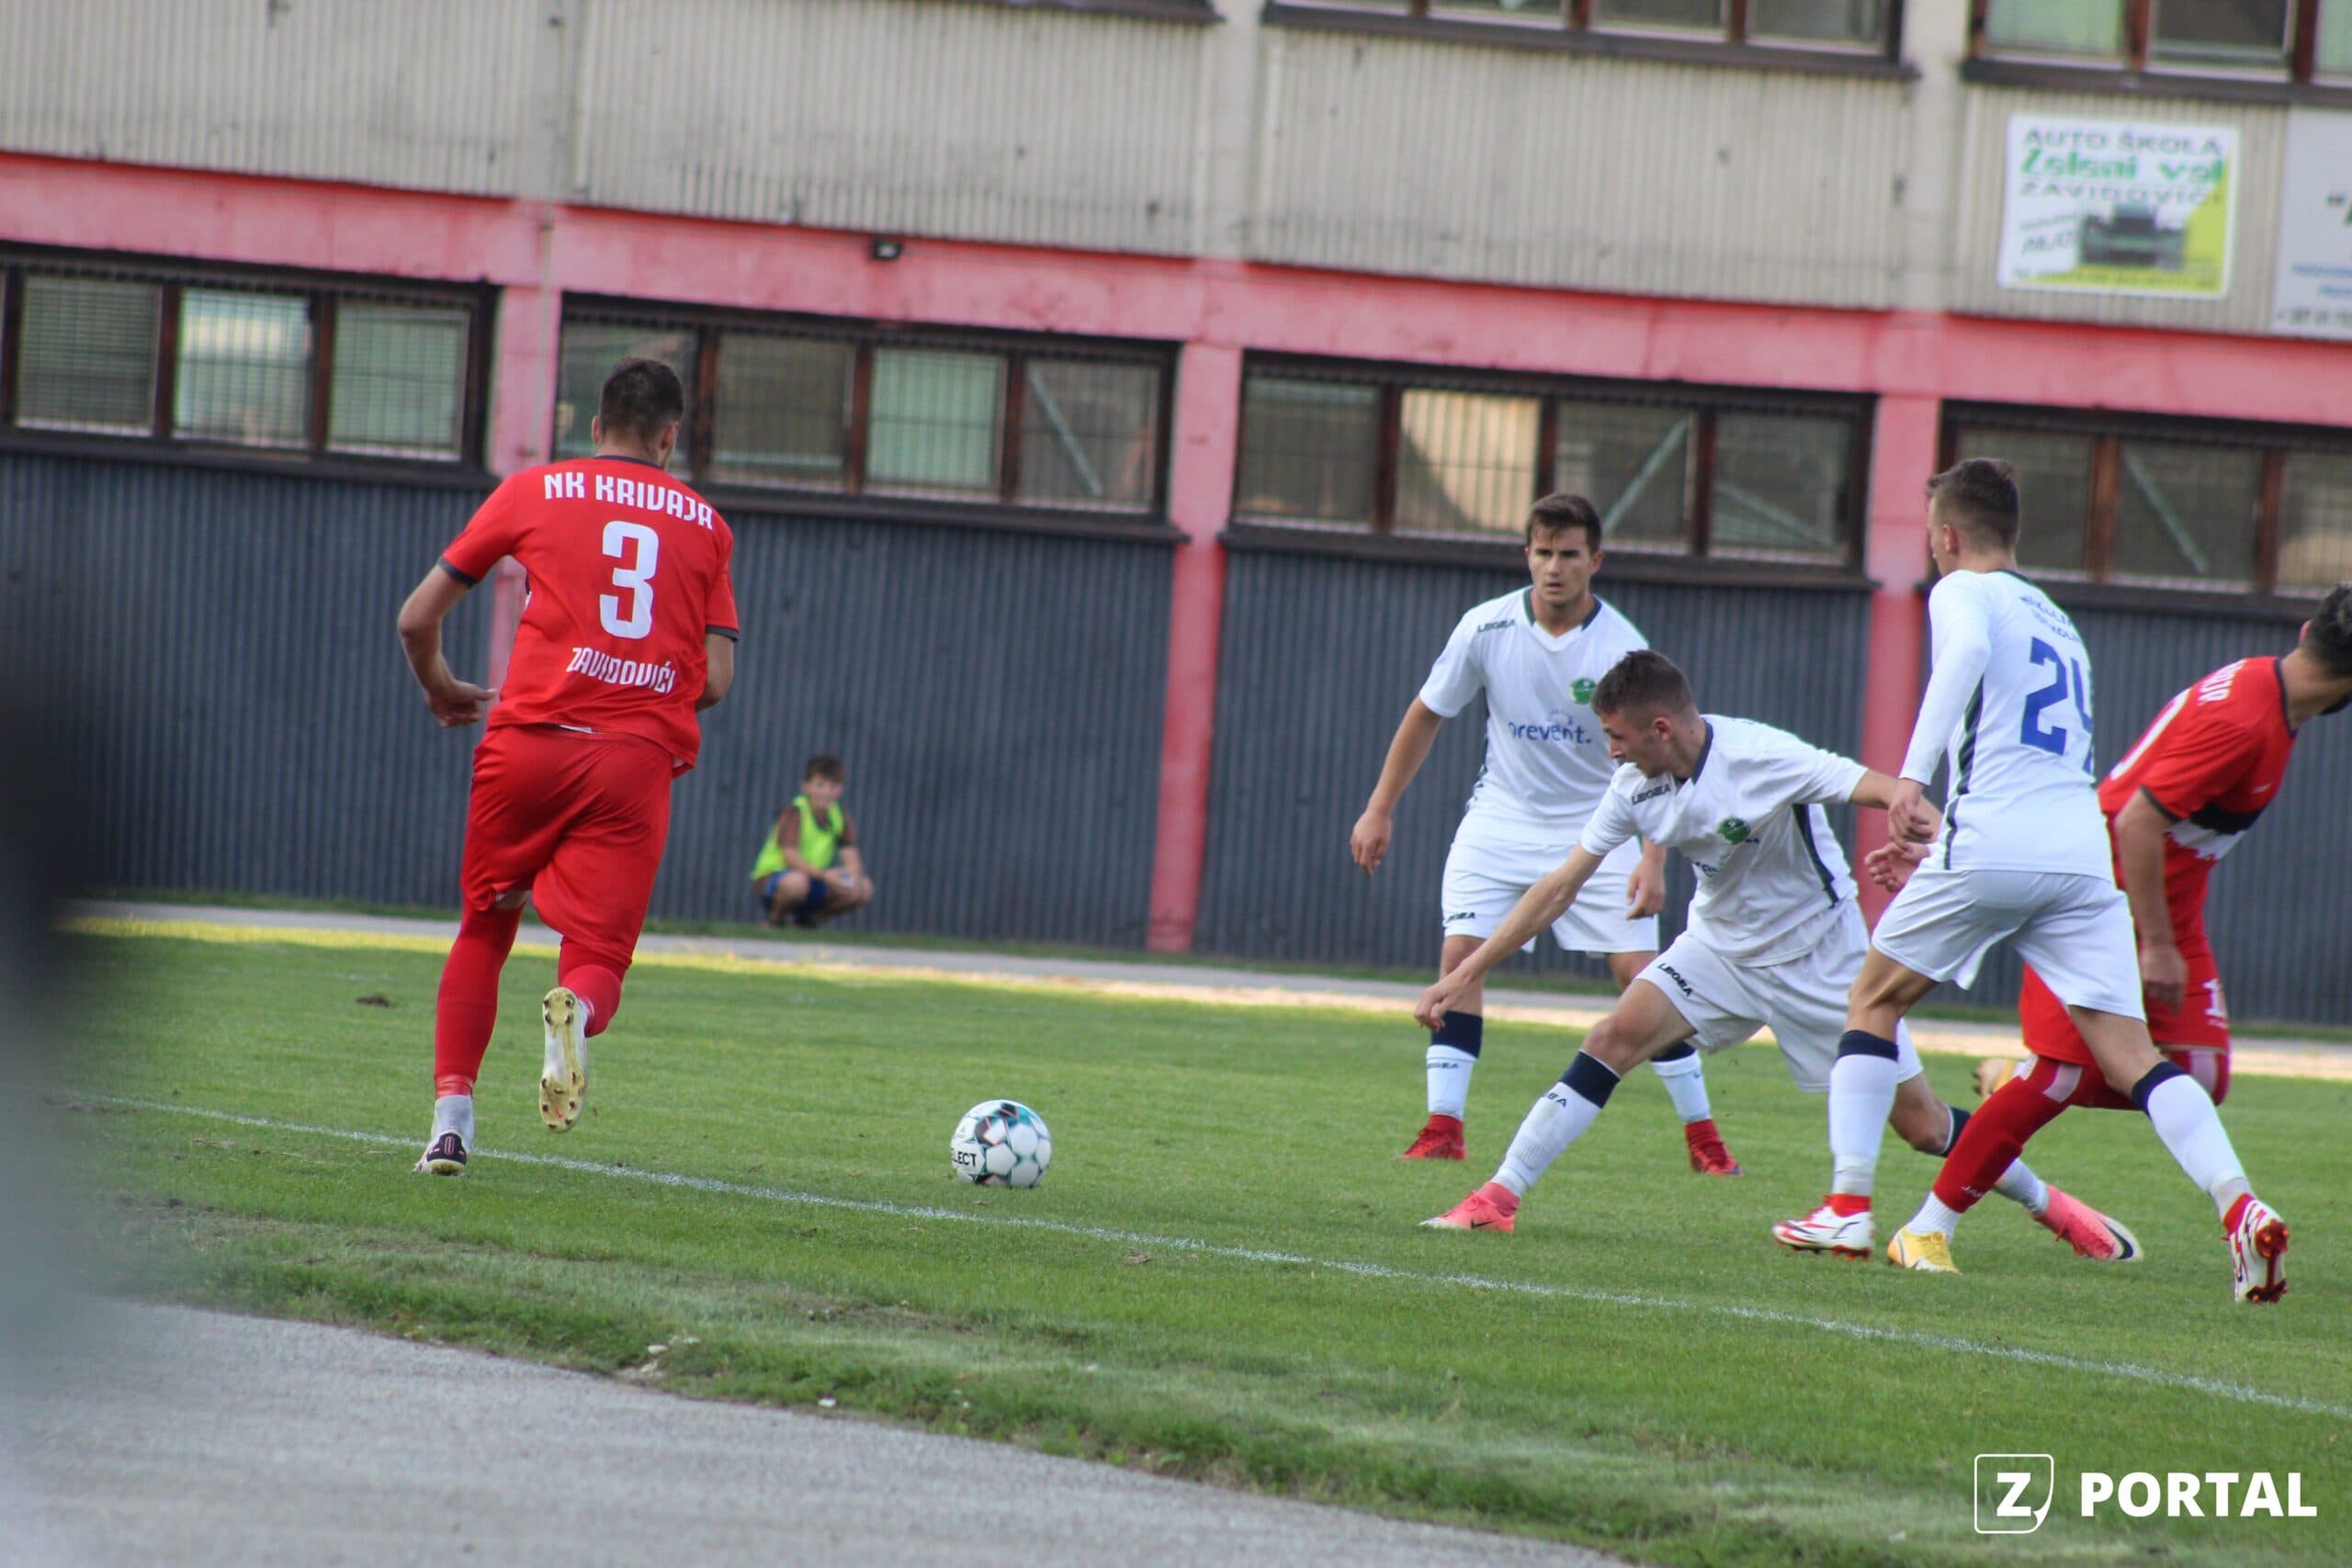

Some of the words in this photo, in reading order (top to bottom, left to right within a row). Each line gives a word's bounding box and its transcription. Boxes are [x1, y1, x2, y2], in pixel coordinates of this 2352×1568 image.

[2023, 130, 2108, 150] AUTO
[2117, 129, 2222, 156] ŠKOLA
[544, 472, 585, 500] NK
[595, 474, 713, 530] KRIVAJA
[599, 520, 660, 639] 3
[566, 647, 677, 694] ZAVIDOVIĆI
[1632, 784, 1671, 805] LEGEA
[1657, 963, 1692, 997] LEGEA
